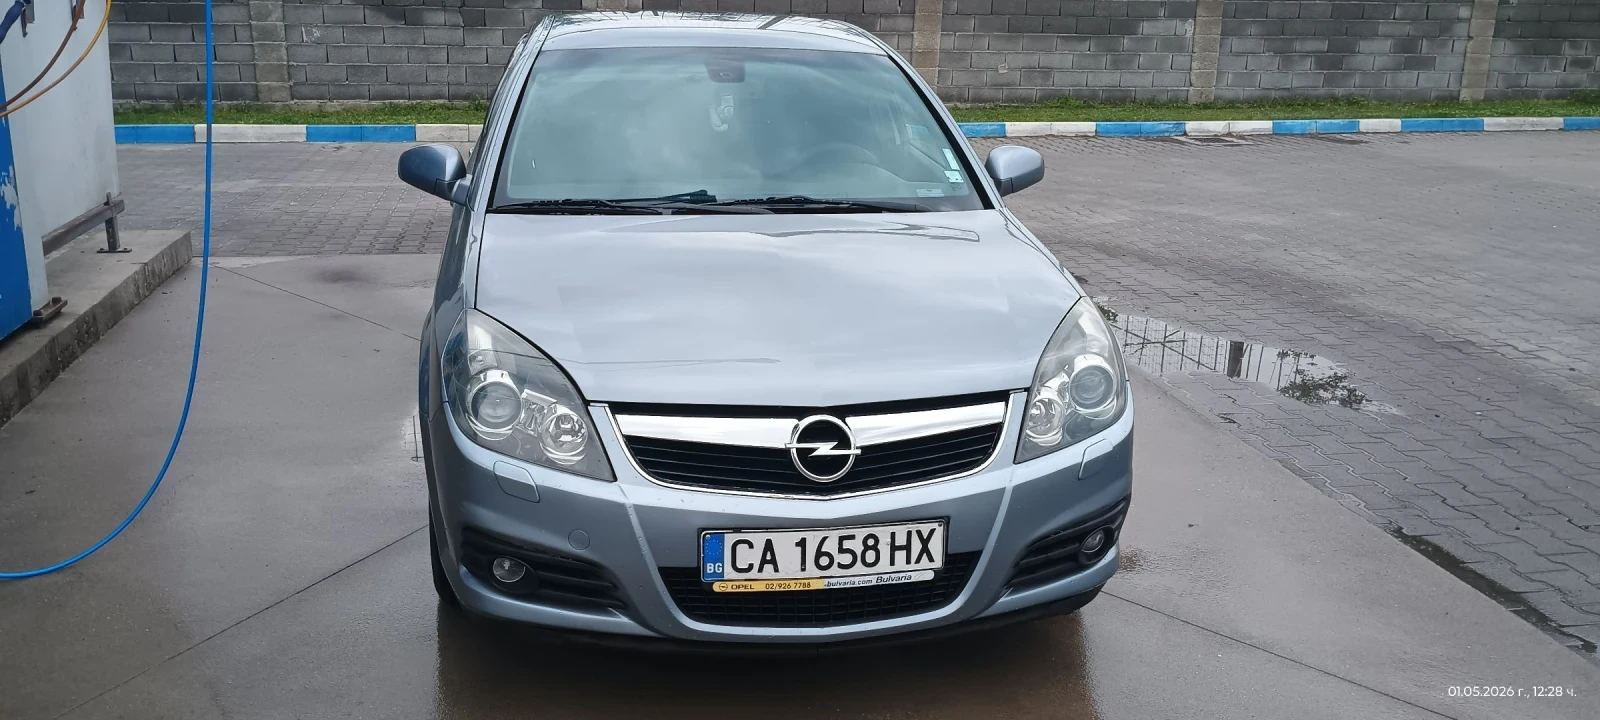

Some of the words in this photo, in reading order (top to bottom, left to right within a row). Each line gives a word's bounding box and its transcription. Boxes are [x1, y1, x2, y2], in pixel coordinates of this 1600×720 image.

[730, 538, 780, 574] CA
[795, 532, 881, 573] 1658
[889, 527, 937, 567] HX
[706, 563, 723, 574] BG
[764, 582, 792, 590] 02/926
[793, 581, 811, 589] 7788
[875, 573, 912, 584] Bulvaria
